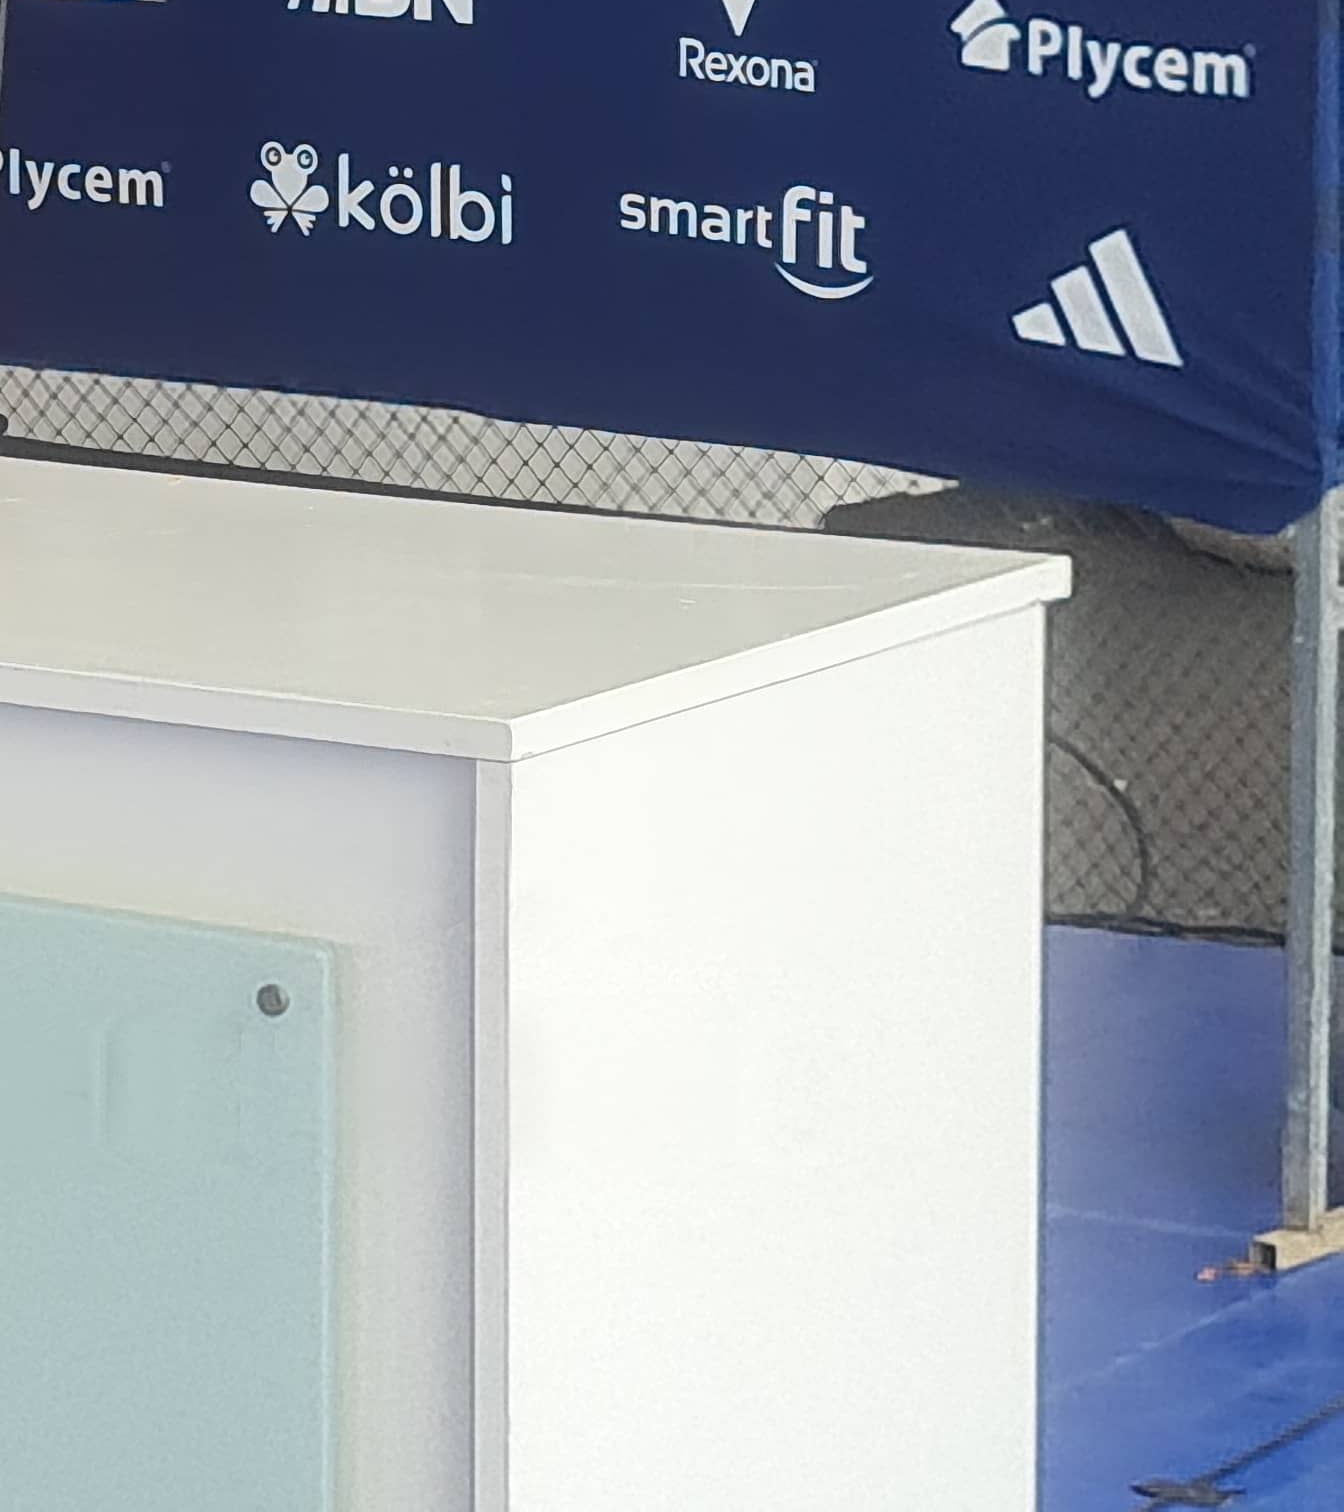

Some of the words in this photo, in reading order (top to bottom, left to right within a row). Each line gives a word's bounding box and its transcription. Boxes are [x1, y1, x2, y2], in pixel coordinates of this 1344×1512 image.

[680, 37, 814, 92] Rexona
[1029, 19, 1247, 97] Plycem
[339, 153, 512, 244] kölbi
